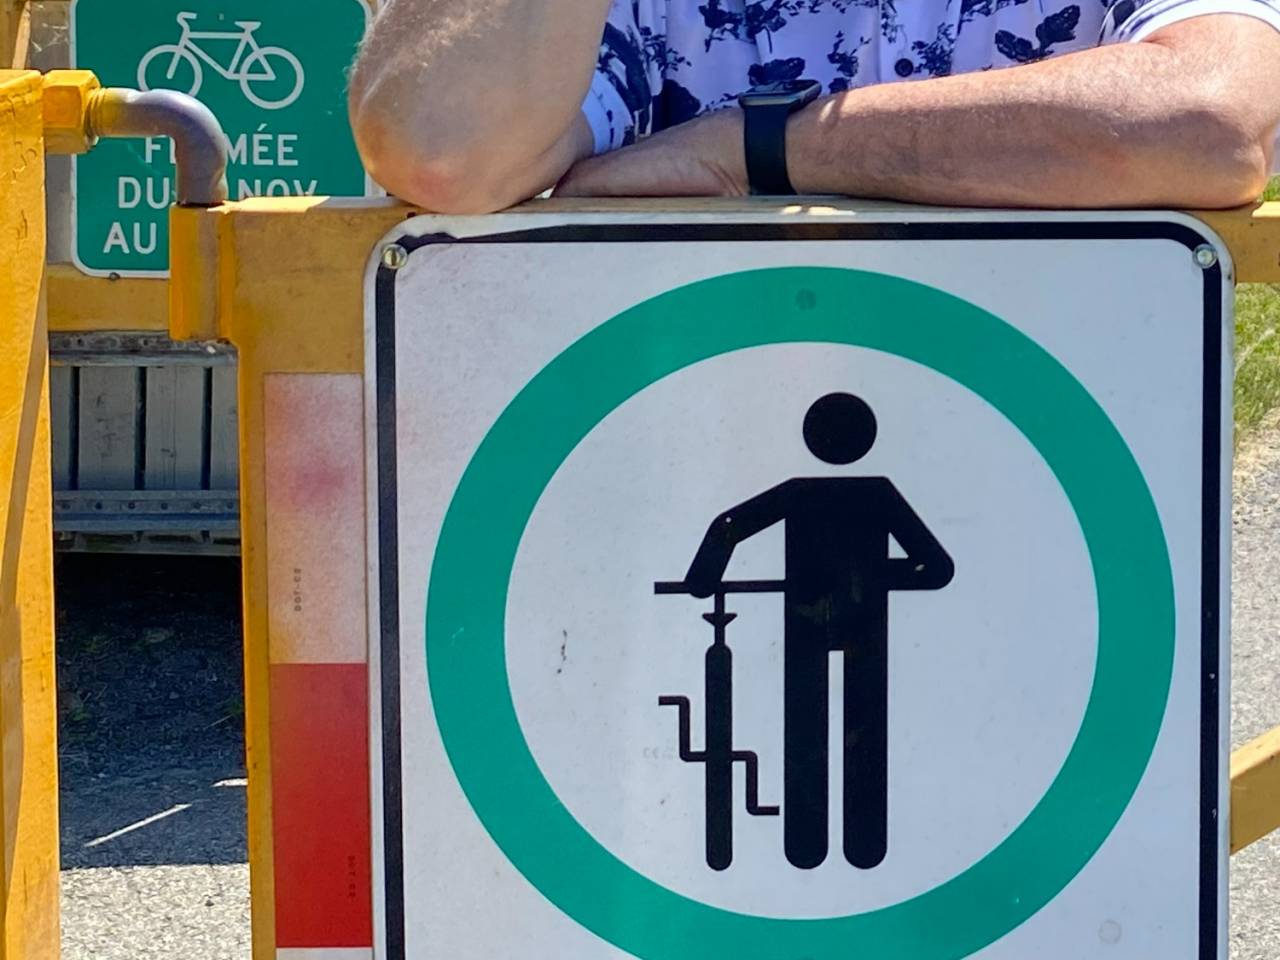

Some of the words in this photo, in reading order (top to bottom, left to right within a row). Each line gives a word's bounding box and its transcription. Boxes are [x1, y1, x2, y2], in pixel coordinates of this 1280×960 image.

[145, 123, 298, 166] FMÉE
[118, 176, 170, 209] DU
[103, 222, 158, 254] AU
